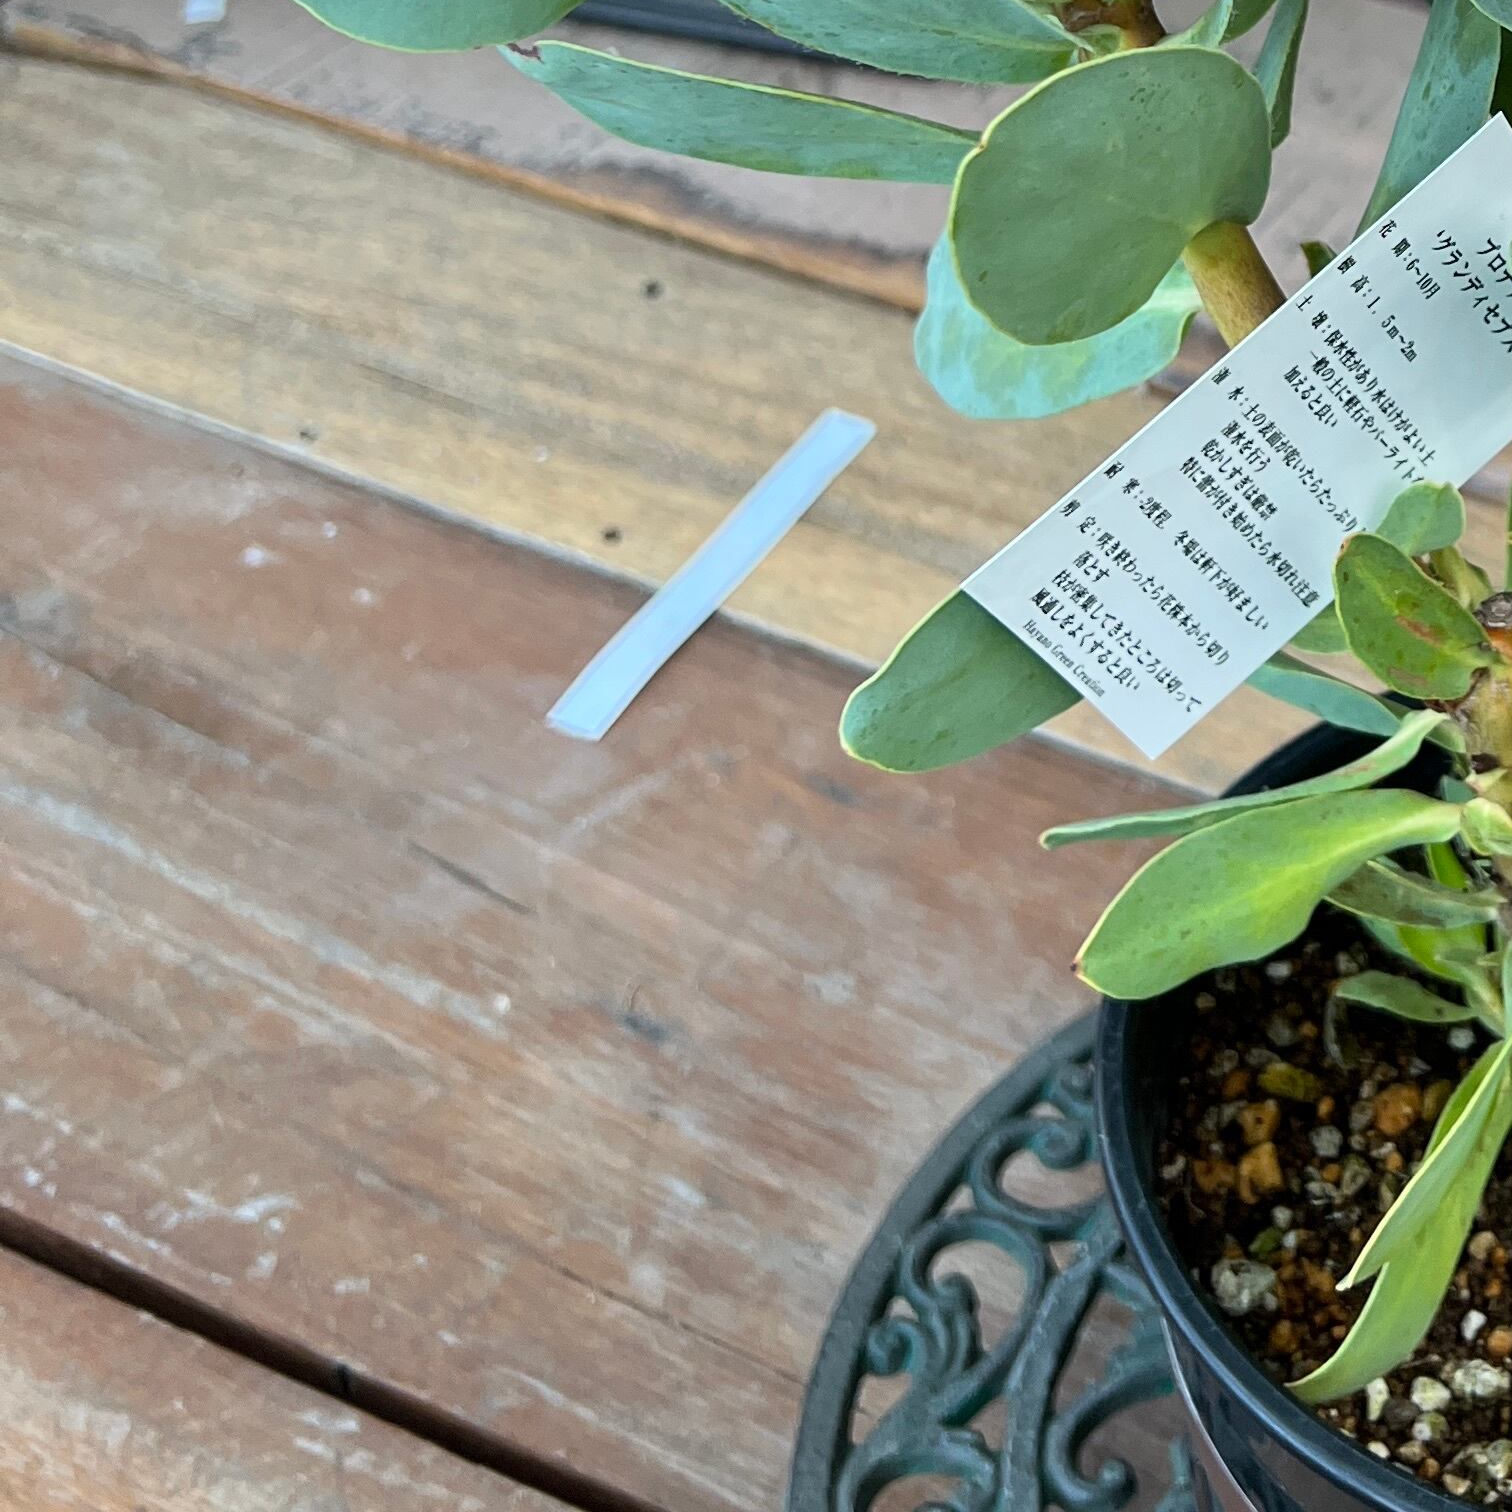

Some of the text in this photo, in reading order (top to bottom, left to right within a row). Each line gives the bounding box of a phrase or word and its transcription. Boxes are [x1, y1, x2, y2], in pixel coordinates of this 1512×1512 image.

[1378, 218, 1398, 239] 花
[1295, 294, 1314, 312] 土
[1282, 364, 1338, 428] 加えると良い
[1227, 385, 1367, 544] 水：土の表面が乾いたらたっぷり
[1071, 550, 1111, 583] 落とす
[1028, 586, 1141, 691] 風通しをよくすると良い
[1050, 644, 1075, 669] Green
[1072, 664, 1106, 698] Creation
